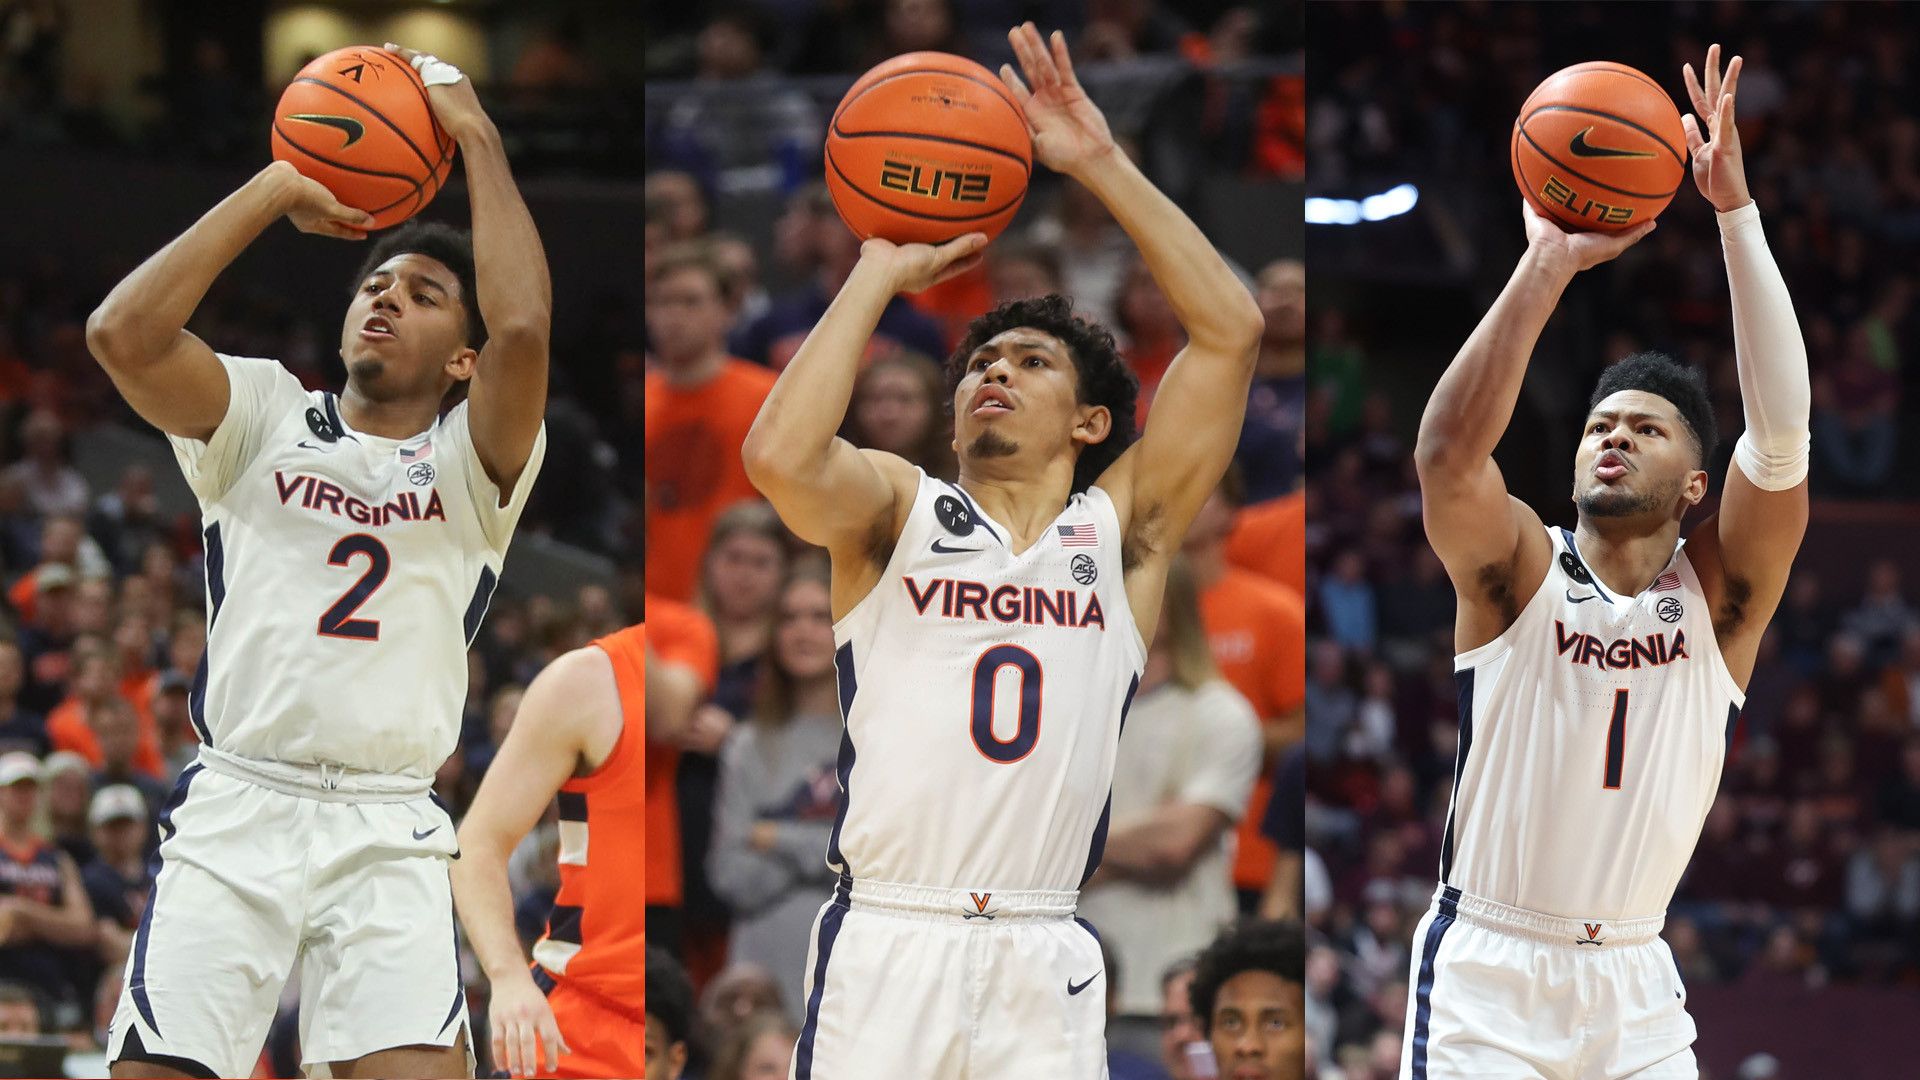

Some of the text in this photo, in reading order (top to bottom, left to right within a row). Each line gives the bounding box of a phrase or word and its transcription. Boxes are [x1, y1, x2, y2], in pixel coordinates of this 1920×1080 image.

[880, 159, 991, 204] ELITE
[1542, 174, 1635, 225] ELITE
[275, 471, 446, 526] VIRGINIA
[943, 500, 953, 512] 15
[951, 516, 956, 526] 1
[957, 511, 968, 523] 41
[317, 533, 392, 641] 2
[1073, 564, 1095, 574] ACC
[902, 576, 1106, 632] VIRGINIA
[1659, 604, 1681, 614] ACC
[970, 643, 1043, 765] 0
[1602, 688, 1629, 790] 1
